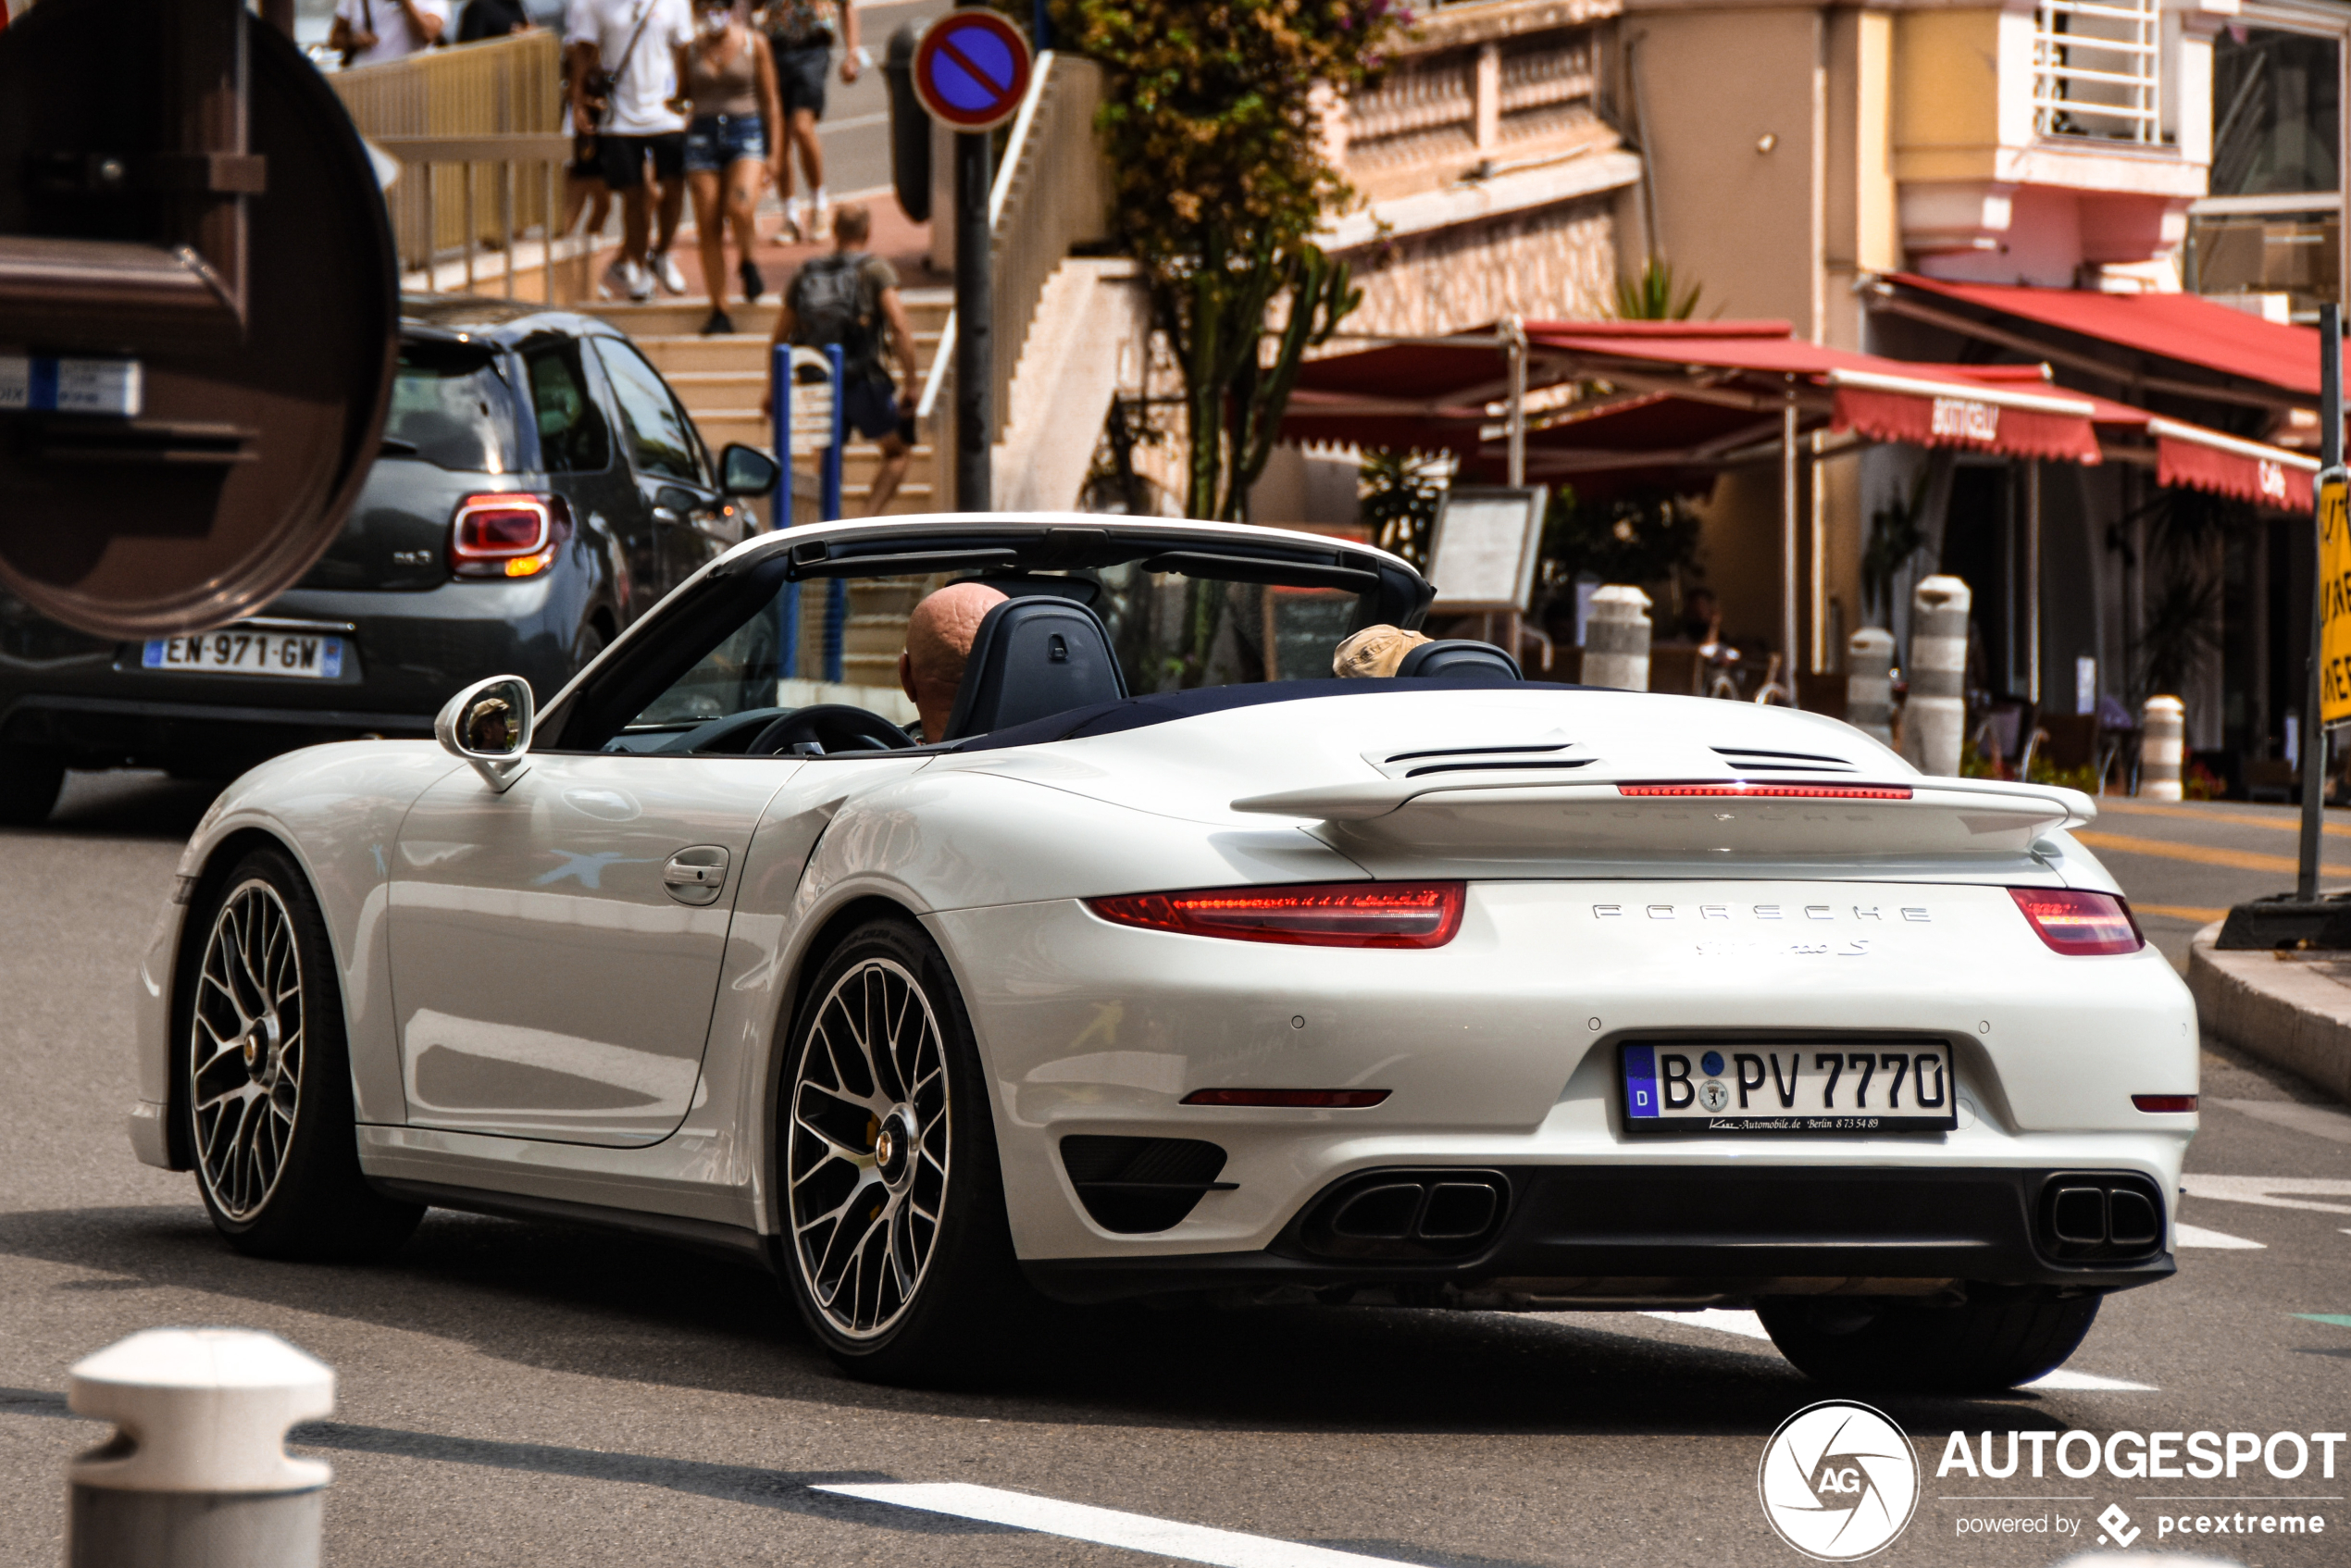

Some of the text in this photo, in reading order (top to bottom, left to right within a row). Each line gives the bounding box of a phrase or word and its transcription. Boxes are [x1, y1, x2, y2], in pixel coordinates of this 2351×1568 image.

[167, 635, 318, 668] EN-971-GW
[1592, 904, 1933, 922] PORSCHE
[1636, 1090, 1648, 1106] D
[1661, 1053, 1696, 1109] B
[1734, 1053, 1800, 1108] PV
[1815, 1053, 1945, 1108] 7770
